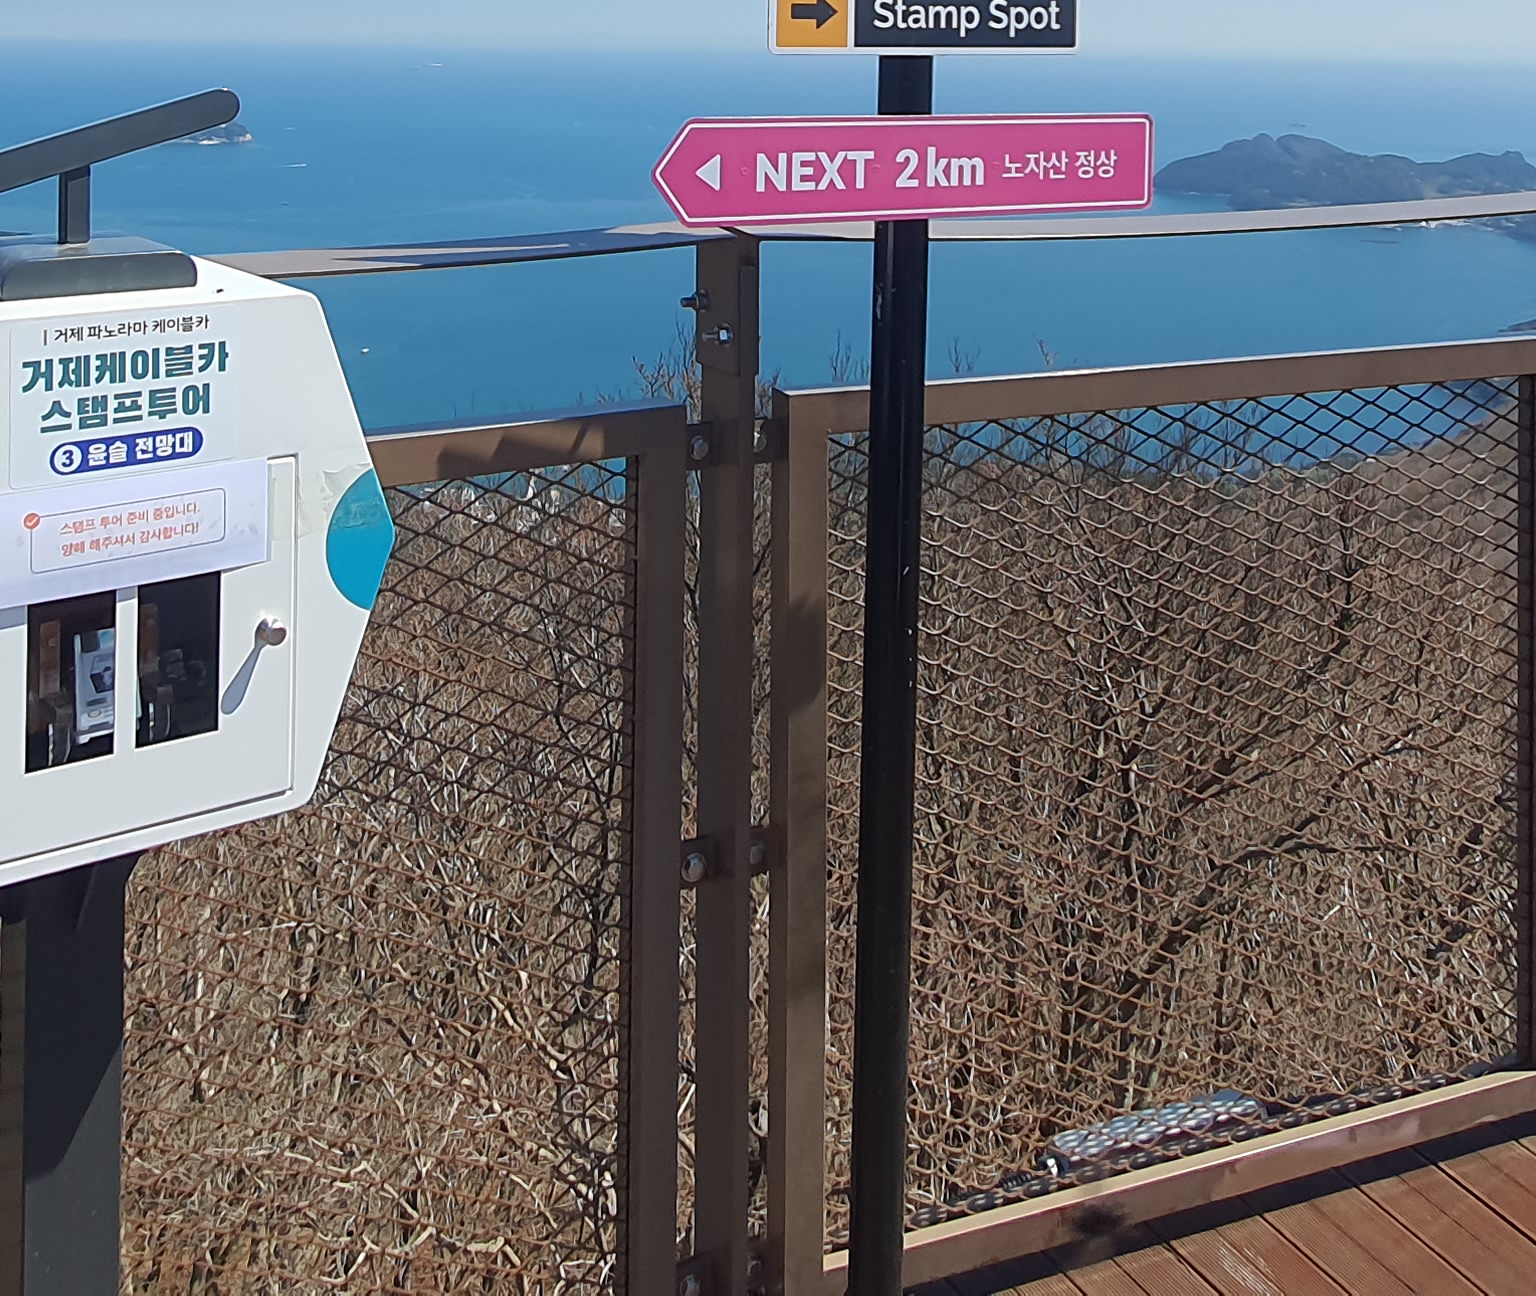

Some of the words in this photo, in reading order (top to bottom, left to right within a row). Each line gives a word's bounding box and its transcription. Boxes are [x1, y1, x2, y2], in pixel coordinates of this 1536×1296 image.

[988, 0, 1061, 37] Spot
[755, 150, 875, 192] NEXT
[1002, 151, 1068, 180] 노자산
[1074, 149, 1117, 179] 정상
[54, 327, 84, 343] 거제
[87, 320, 148, 340] 파노라마
[152, 314, 210, 334] 케이블카
[21, 340, 229, 393] 거제케이블카
[40, 382, 211, 434] 스탬프투어
[87, 440, 128, 467] 윤슬
[135, 431, 193, 459] 전망대
[100, 515, 123, 528] 투어
[126, 509, 149, 523] 준비
[62, 542, 85, 557] 양해
[139, 522, 199, 542] 감사합니다!
